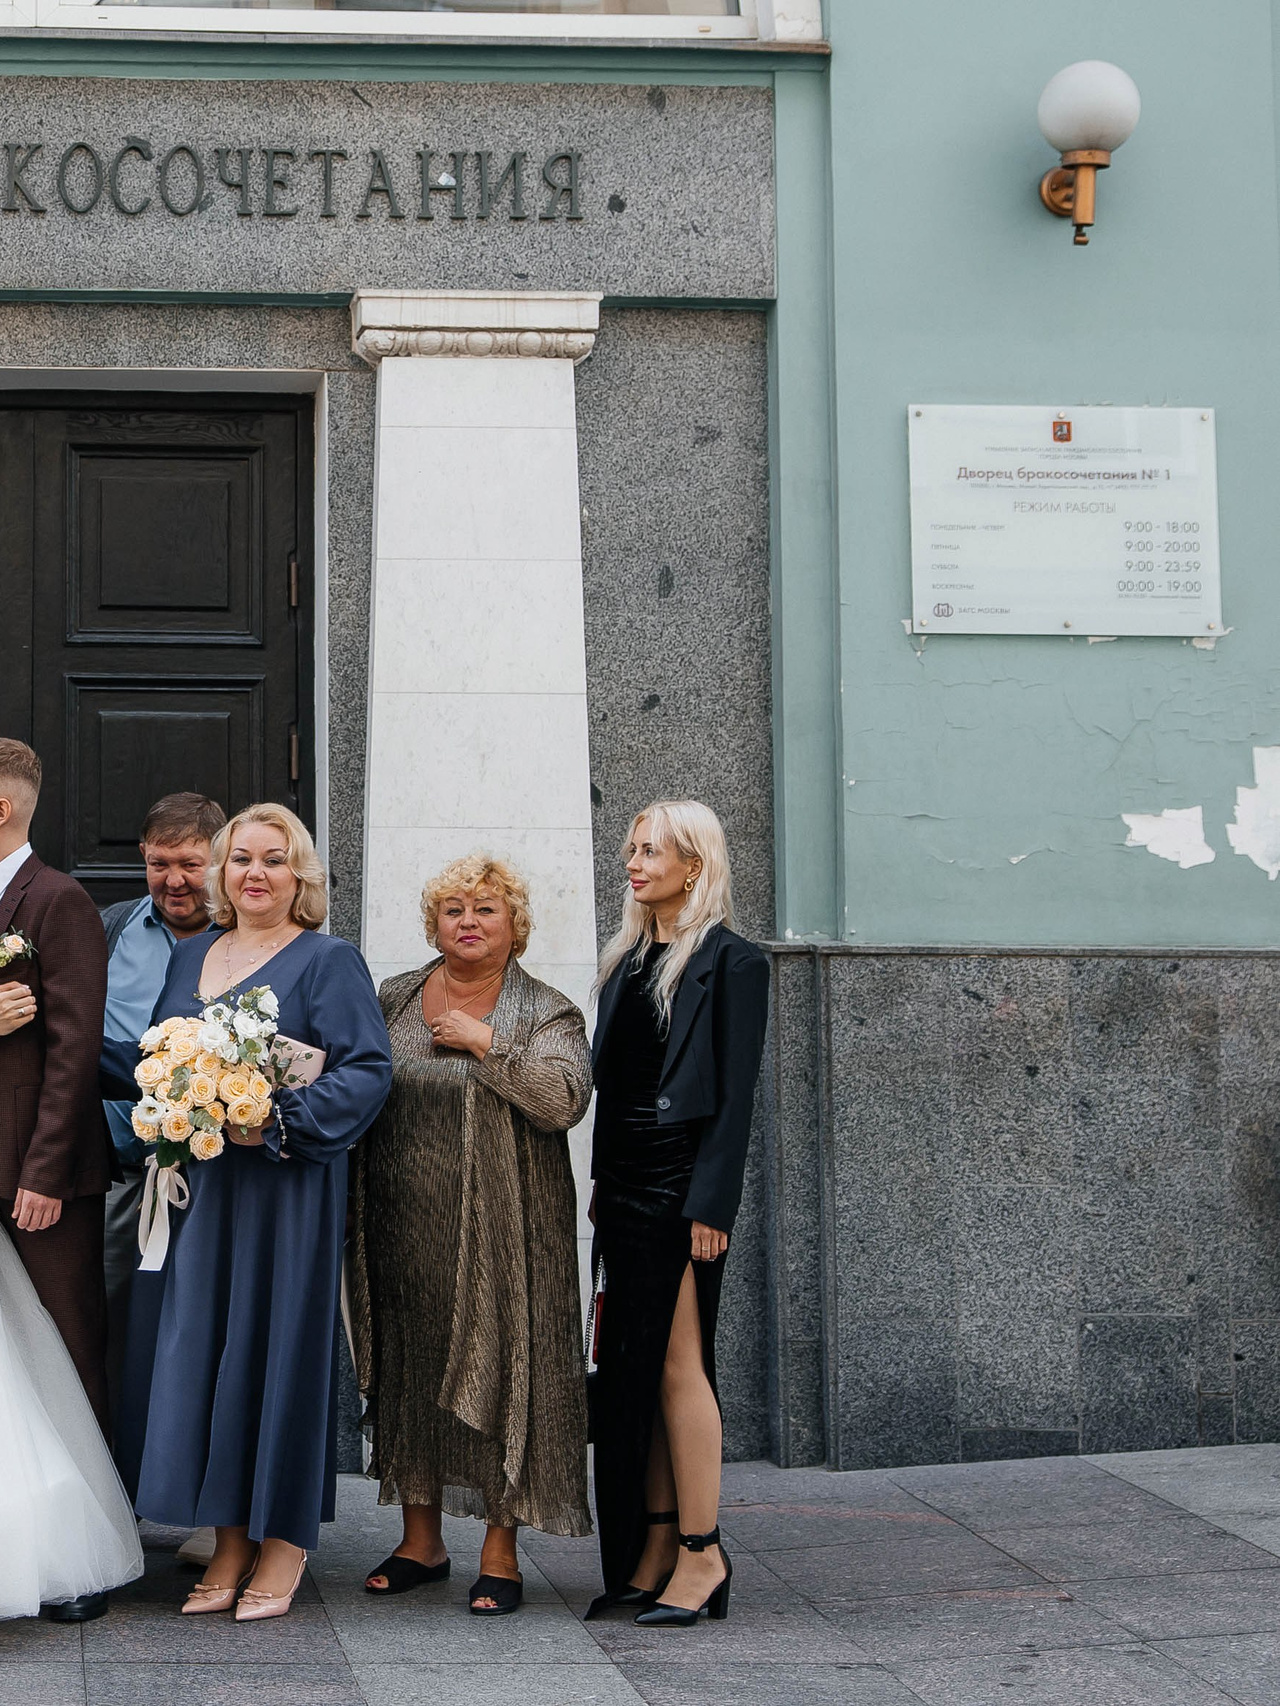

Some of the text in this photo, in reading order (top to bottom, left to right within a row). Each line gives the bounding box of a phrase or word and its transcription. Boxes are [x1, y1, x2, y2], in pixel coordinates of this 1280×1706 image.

[956, 467, 1014, 481] Дворец
[1017, 467, 1138, 481] бракосочетания
[1165, 469, 1171, 481] 1
[1013, 501, 1117, 513] РЕЖИМ РАБОТЫ
[1124, 521, 1153, 533] 9:00
[1166, 521, 1200, 533] 18:00
[1124, 540, 1154, 552] 9:00
[1163, 541, 1201, 553] 20:00
[1125, 560, 1154, 572] 9:00
[1164, 560, 1201, 573] 23:59
[1117, 580, 1155, 592] 00:00
[1166, 580, 1202, 592] 19:00
